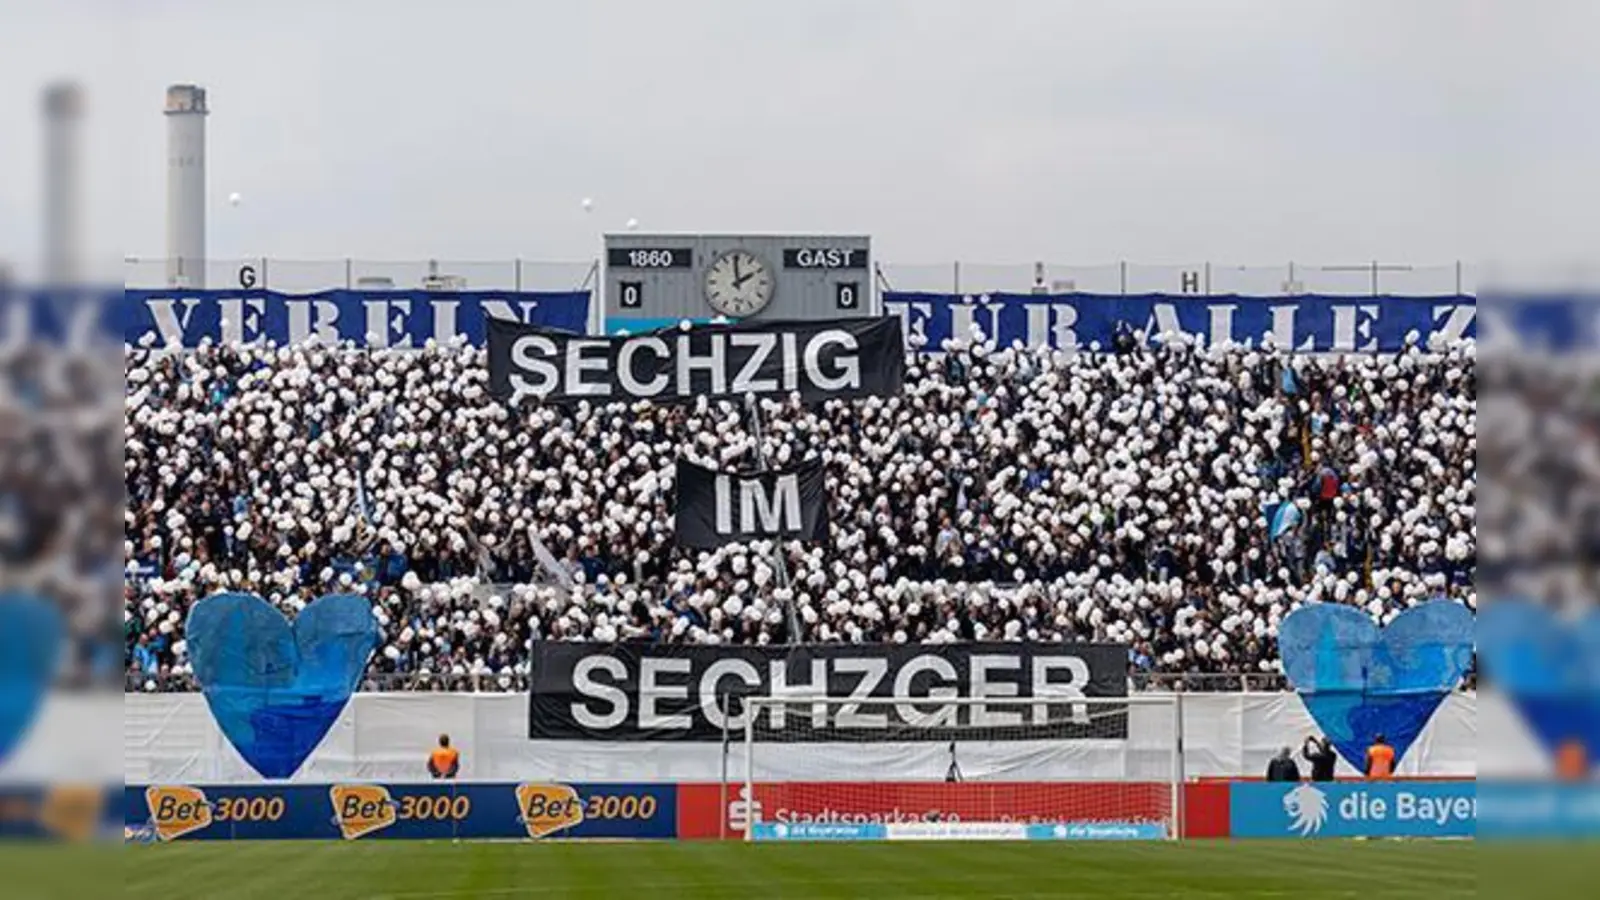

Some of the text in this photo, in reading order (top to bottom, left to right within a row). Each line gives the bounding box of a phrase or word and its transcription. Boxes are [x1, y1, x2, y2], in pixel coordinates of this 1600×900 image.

[628, 250, 674, 267] 1860
[796, 249, 854, 267] GAST
[239, 266, 256, 289] G
[1182, 271, 1199, 293] H
[623, 285, 638, 305] 0
[1144, 303, 1379, 351] ALLE
[509, 328, 861, 397] SECHZIG
[715, 473, 802, 535] IM
[570, 654, 1091, 730] SECHZGER
[1339, 793, 1387, 820] die
